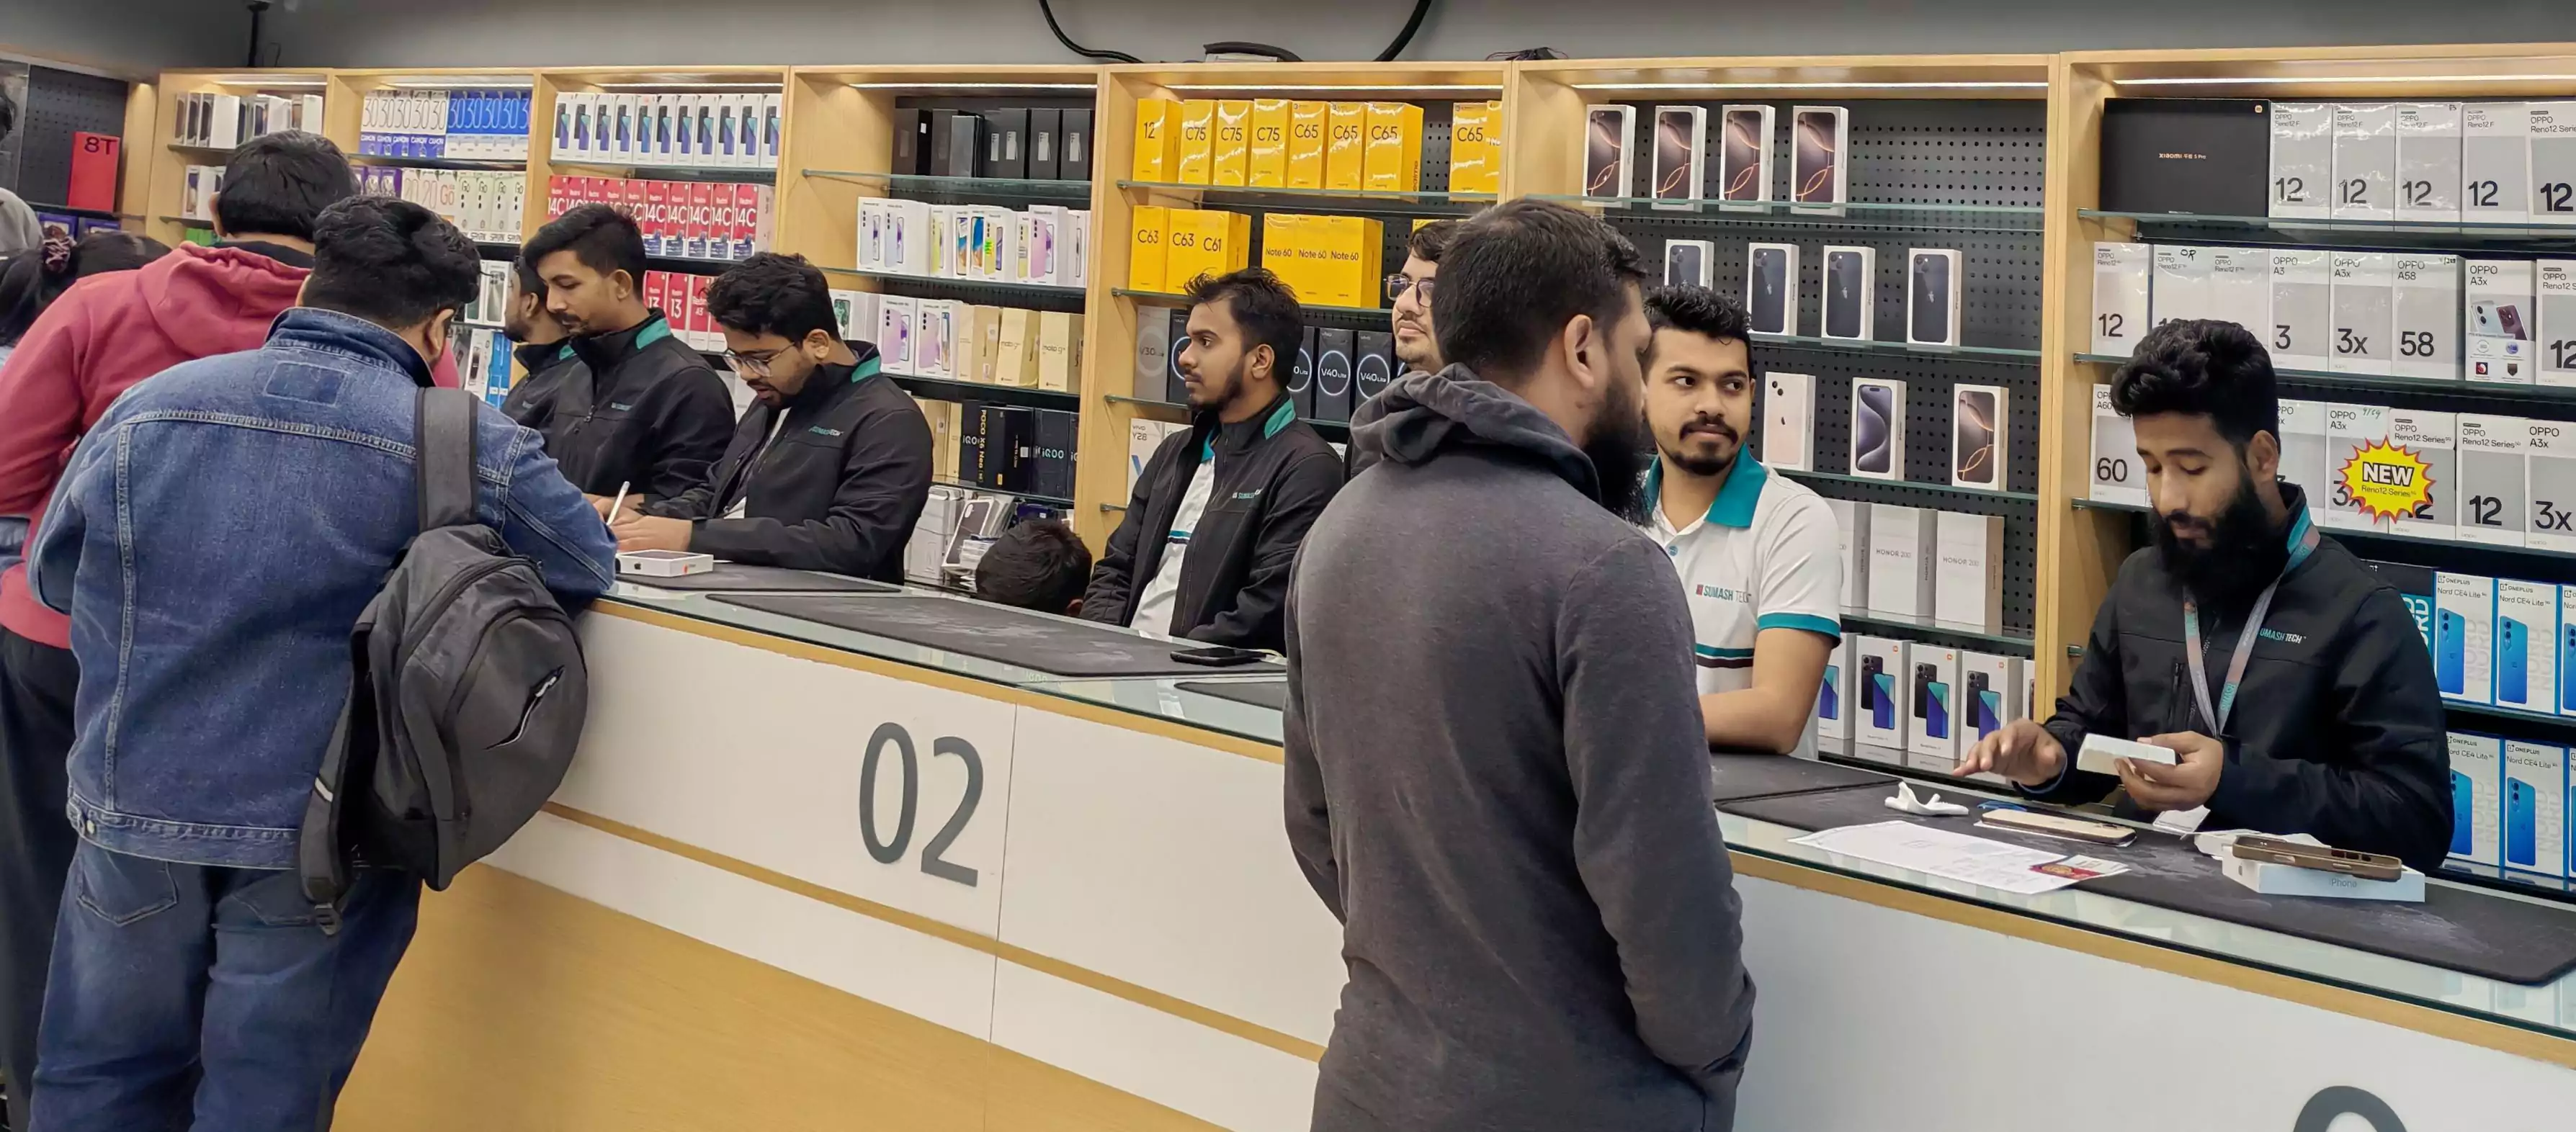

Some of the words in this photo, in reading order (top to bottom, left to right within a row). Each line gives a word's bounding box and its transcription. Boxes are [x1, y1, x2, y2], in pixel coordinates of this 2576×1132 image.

[362, 99, 380, 127] 30
[379, 99, 395, 128] 30
[394, 99, 412, 129] 30
[413, 99, 430, 129] 30
[430, 100, 447, 130] 30
[448, 98, 466, 129] 30
[465, 98, 483, 129] 30
[483, 98, 501, 129] 30
[501, 98, 519, 129] 30
[1144, 122, 1155, 139] 12
[1186, 127, 1207, 141] C75
[1221, 127, 1242, 141] C75
[1257, 127, 1280, 141] C75
[1294, 124, 1319, 138] C65
[1333, 125, 1358, 140] C65
[1372, 125, 1397, 140] C65
[1457, 127, 1483, 142] C65
[84, 137, 118, 156] 8T
[2276, 178, 2303, 202] 12
[2338, 179, 2366, 204] 12
[2402, 181, 2431, 206] 12
[2468, 180, 2498, 206] 12
[2540, 183, 2574, 212] 12
[644, 203, 666, 223] 14C
[667, 205, 687, 224] 14C
[689, 206, 710, 225] 14C
[712, 207, 731, 226] 14C
[735, 207, 756, 227] 14C
[1137, 230, 1158, 243] C63
[1172, 233, 1194, 246] C63
[1203, 237, 1222, 252] C61
[1266, 247, 1282, 256] Note
[1282, 248, 1292, 257] 60
[1299, 249, 1317, 259] Note
[1318, 250, 1327, 259] 60
[1331, 251, 1349, 260] Note
[1350, 252, 1359, 261] 60
[2273, 256, 2298, 266] OPPO
[2334, 259, 2360, 268] OPPO
[2397, 261, 2425, 270] OPPO
[2470, 265, 2497, 274] OPPO
[2334, 269, 2351, 278] A3x
[2397, 271, 2416, 280] A58
[2470, 277, 2487, 286] A3x
[2543, 282, 2570, 290] Reno12
[671, 298, 682, 318] 13
[2098, 313, 2123, 337] 12
[2275, 325, 2291, 349] 3
[2336, 328, 2368, 354] 3x
[2400, 331, 2435, 357] 58
[1321, 369, 1338, 377] V40
[1360, 372, 1377, 382] V40
[2096, 401, 2112, 410] A60
[2330, 410, 2356, 420] OPPO
[2330, 421, 2347, 430] A3x
[2463, 428, 2486, 436] OPPO
[2529, 426, 2559, 437] OPPO
[2462, 437, 2490, 446] Reno12
[2530, 438, 2549, 448] A3x
[1042, 449, 1065, 459] iQOO
[2097, 457, 2127, 482] 60
[2363, 462, 2415, 487] NEW
[2361, 485, 2387, 495] Reno12
[2469, 495, 2503, 526] 12
[2535, 500, 2573, 531] 3x
[1704, 585, 1733, 601] SUMASH
[2259, 628, 2285, 641] UMASH
[2285, 633, 2302, 644] TECH
[859, 722, 984, 888] 02
[2329, 878, 2357, 888] iPhone
